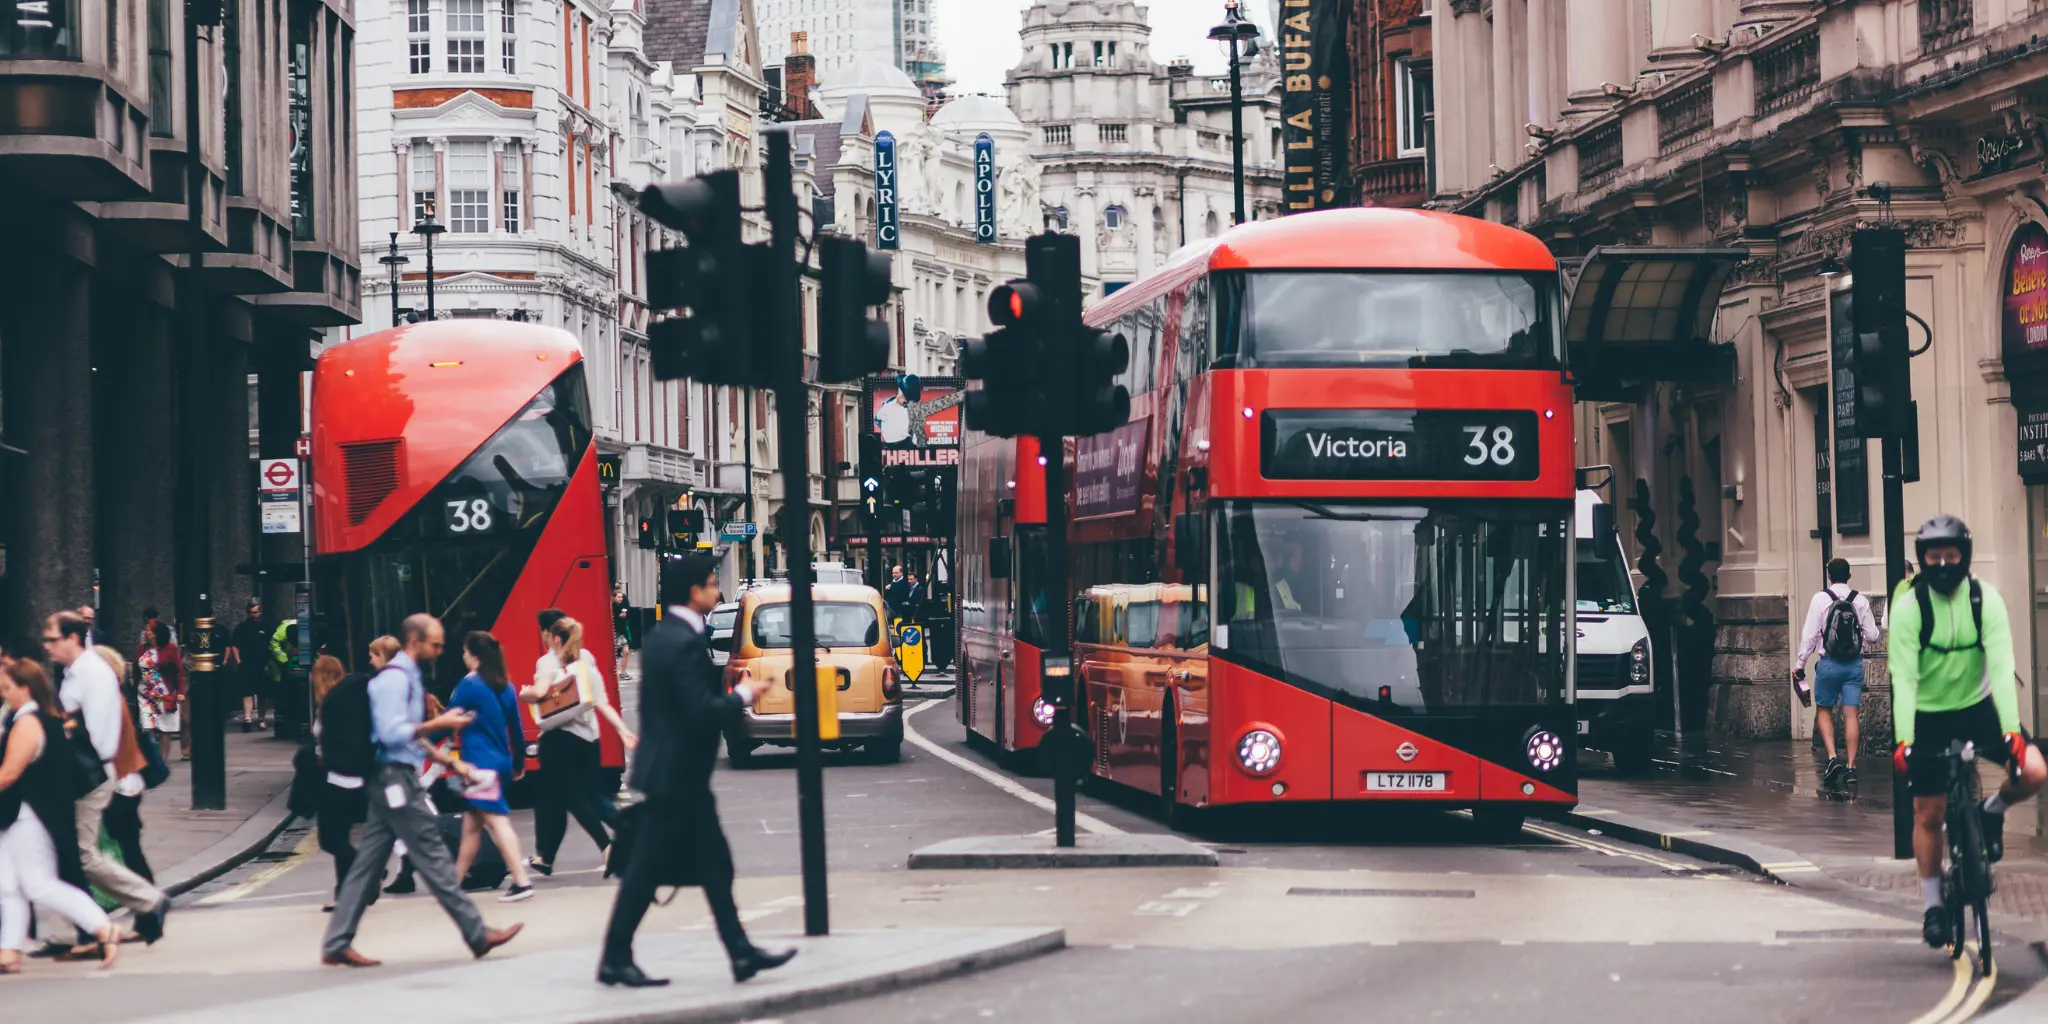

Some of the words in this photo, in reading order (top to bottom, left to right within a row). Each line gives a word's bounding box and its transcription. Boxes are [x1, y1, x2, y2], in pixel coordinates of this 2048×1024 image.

[1287, 108, 1314, 150] LA
[877, 151, 895, 242] LYRIC
[977, 149, 993, 237] APOLLO
[2012, 267, 2047, 296] Believe
[2019, 304, 2029, 325] or
[2027, 324, 2048, 344] LONDON
[296, 440, 310, 455] H
[881, 449, 958, 466] THRILLER
[1306, 432, 1407, 458] Victoria
[1462, 425, 1516, 466] 38
[447, 498, 492, 532] 38
[1377, 774, 1404, 788] LTZ
[1408, 774, 1433, 788] 1178
